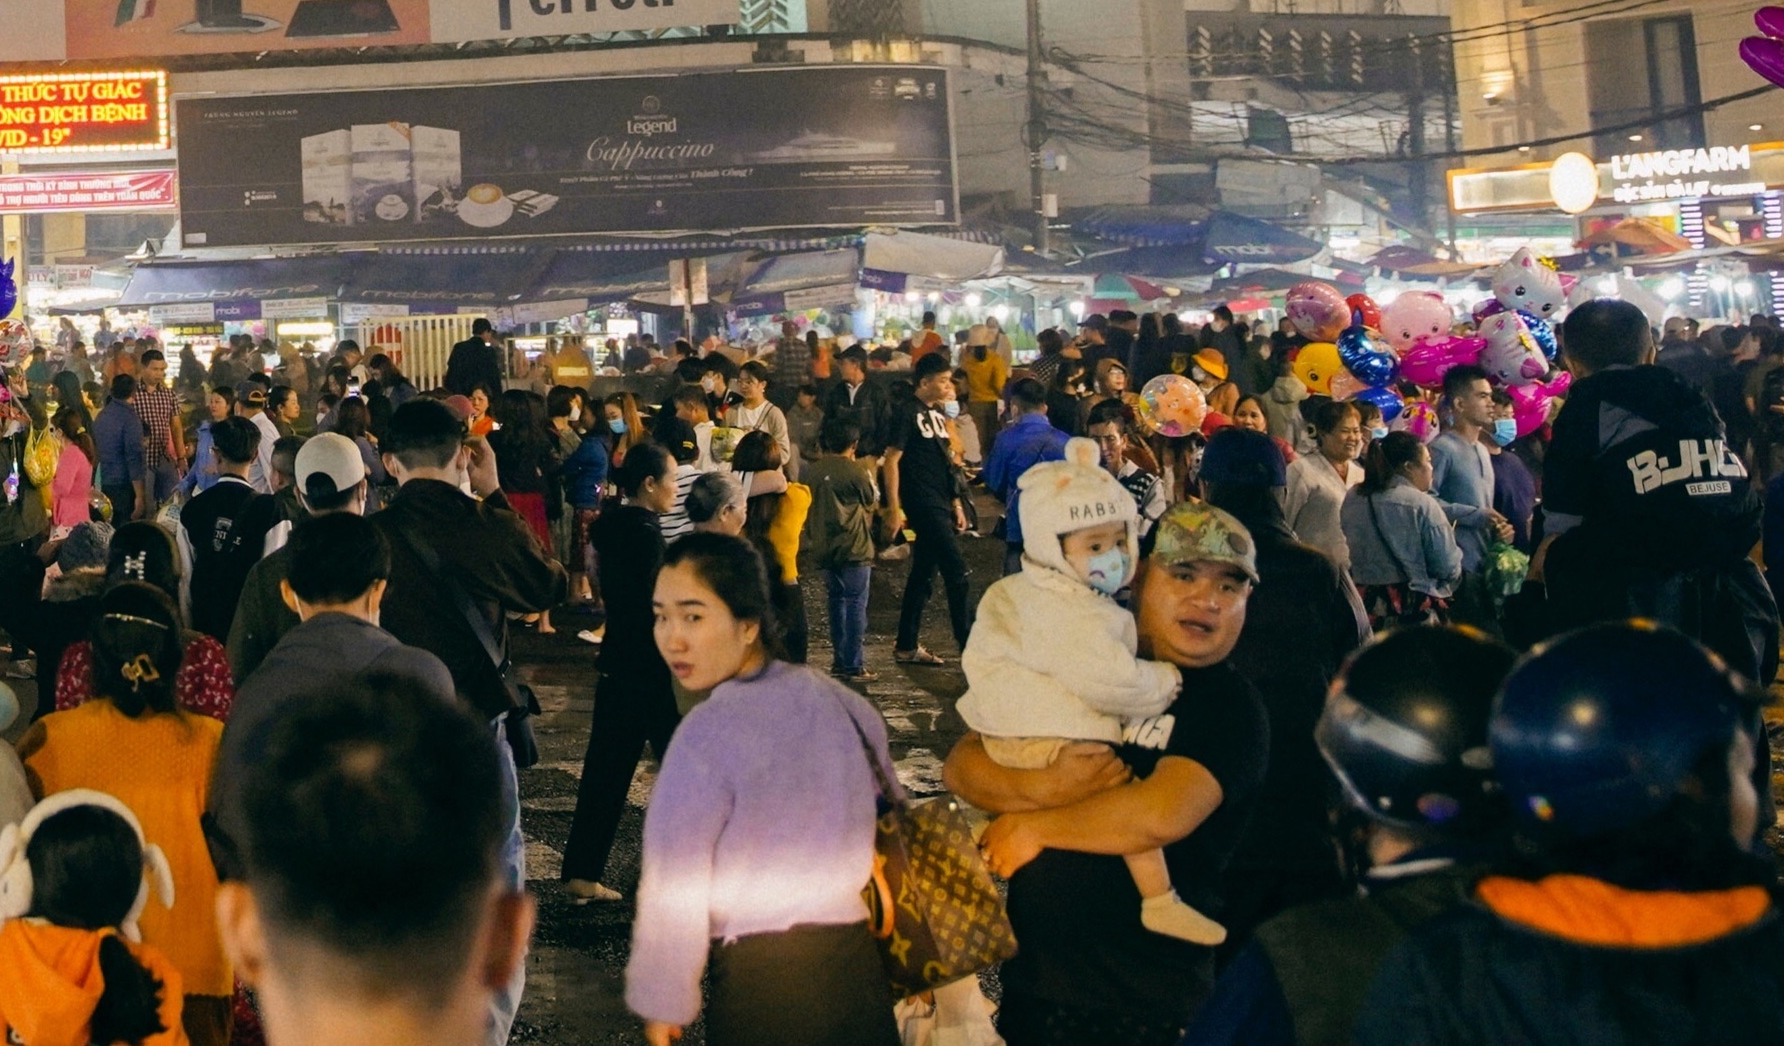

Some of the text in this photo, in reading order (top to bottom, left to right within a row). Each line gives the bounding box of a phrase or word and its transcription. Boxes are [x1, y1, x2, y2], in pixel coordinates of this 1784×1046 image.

[38, 106, 88, 127] DỊCH
[627, 117, 677, 136] Legend
[42, 127, 71, 146] 19"
[586, 136, 715, 171] Cappuccino
[144, 283, 319, 300] mobifone
[1689, 481, 1729, 494] BEJUSE
